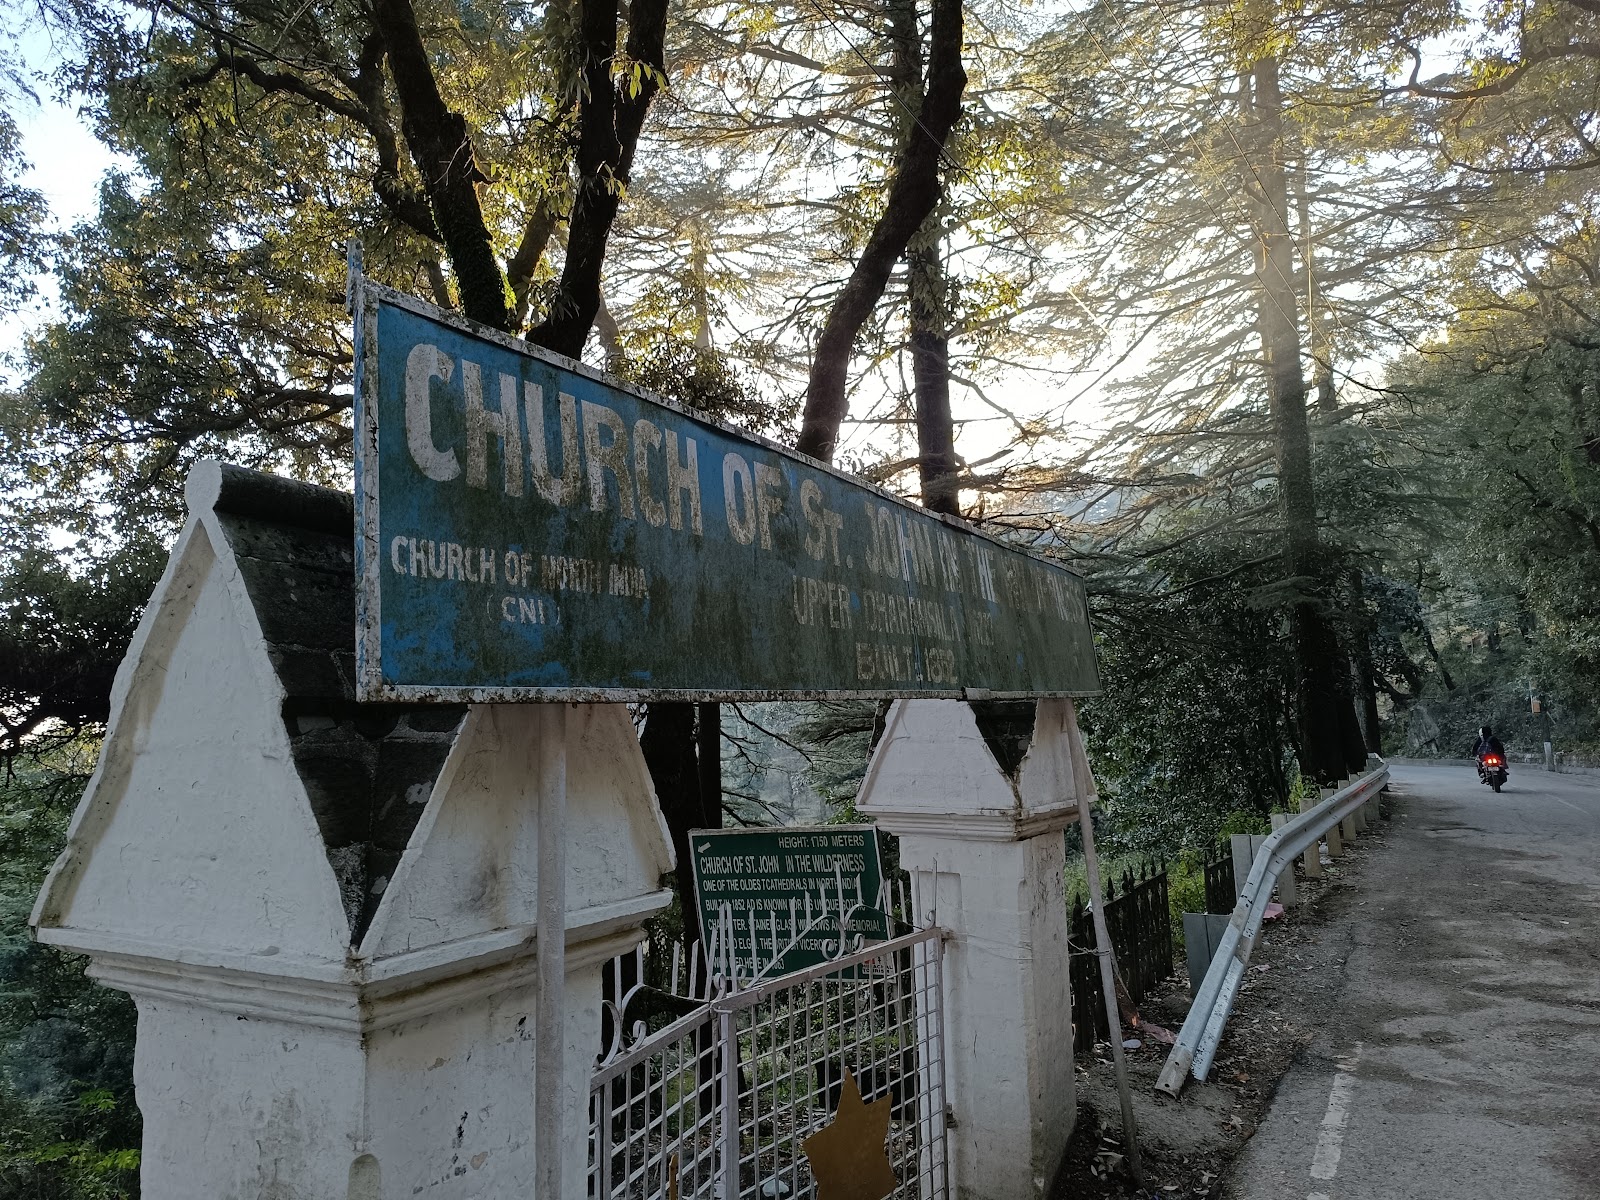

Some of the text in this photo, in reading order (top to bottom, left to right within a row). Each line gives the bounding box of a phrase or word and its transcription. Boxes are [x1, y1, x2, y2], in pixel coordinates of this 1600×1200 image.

[404, 343, 704, 536] CHURCH
[722, 452, 783, 551] OF
[864, 500, 938, 588] JOHN
[391, 535, 496, 585] CHURCH
[504, 549, 534, 587] OF
[793, 575, 853, 630] UPPER
[778, 836, 809, 848] HEIGHT:
[831, 834, 865, 847] METERS
[700, 853, 866, 875] CHURCH OF ST. JOHN IN THE WILDERNESS
[703, 880, 717, 892] ONE
[717, 879, 726, 891] OF
[726, 879, 740, 891] THE
[808, 878, 816, 890] IN
[841, 877, 858, 890] NDIA
[731, 898, 746, 911] 1852
[746, 898, 756, 911] AD
[756, 898, 764, 911] IS
[763, 898, 788, 911] KNOWN
[802, 898, 814, 911] IS
[814, 898, 839, 912] UNQUE
[759, 937, 773, 950] THE
[800, 938, 827, 951] VICERO
[743, 957, 762, 969] HEE
